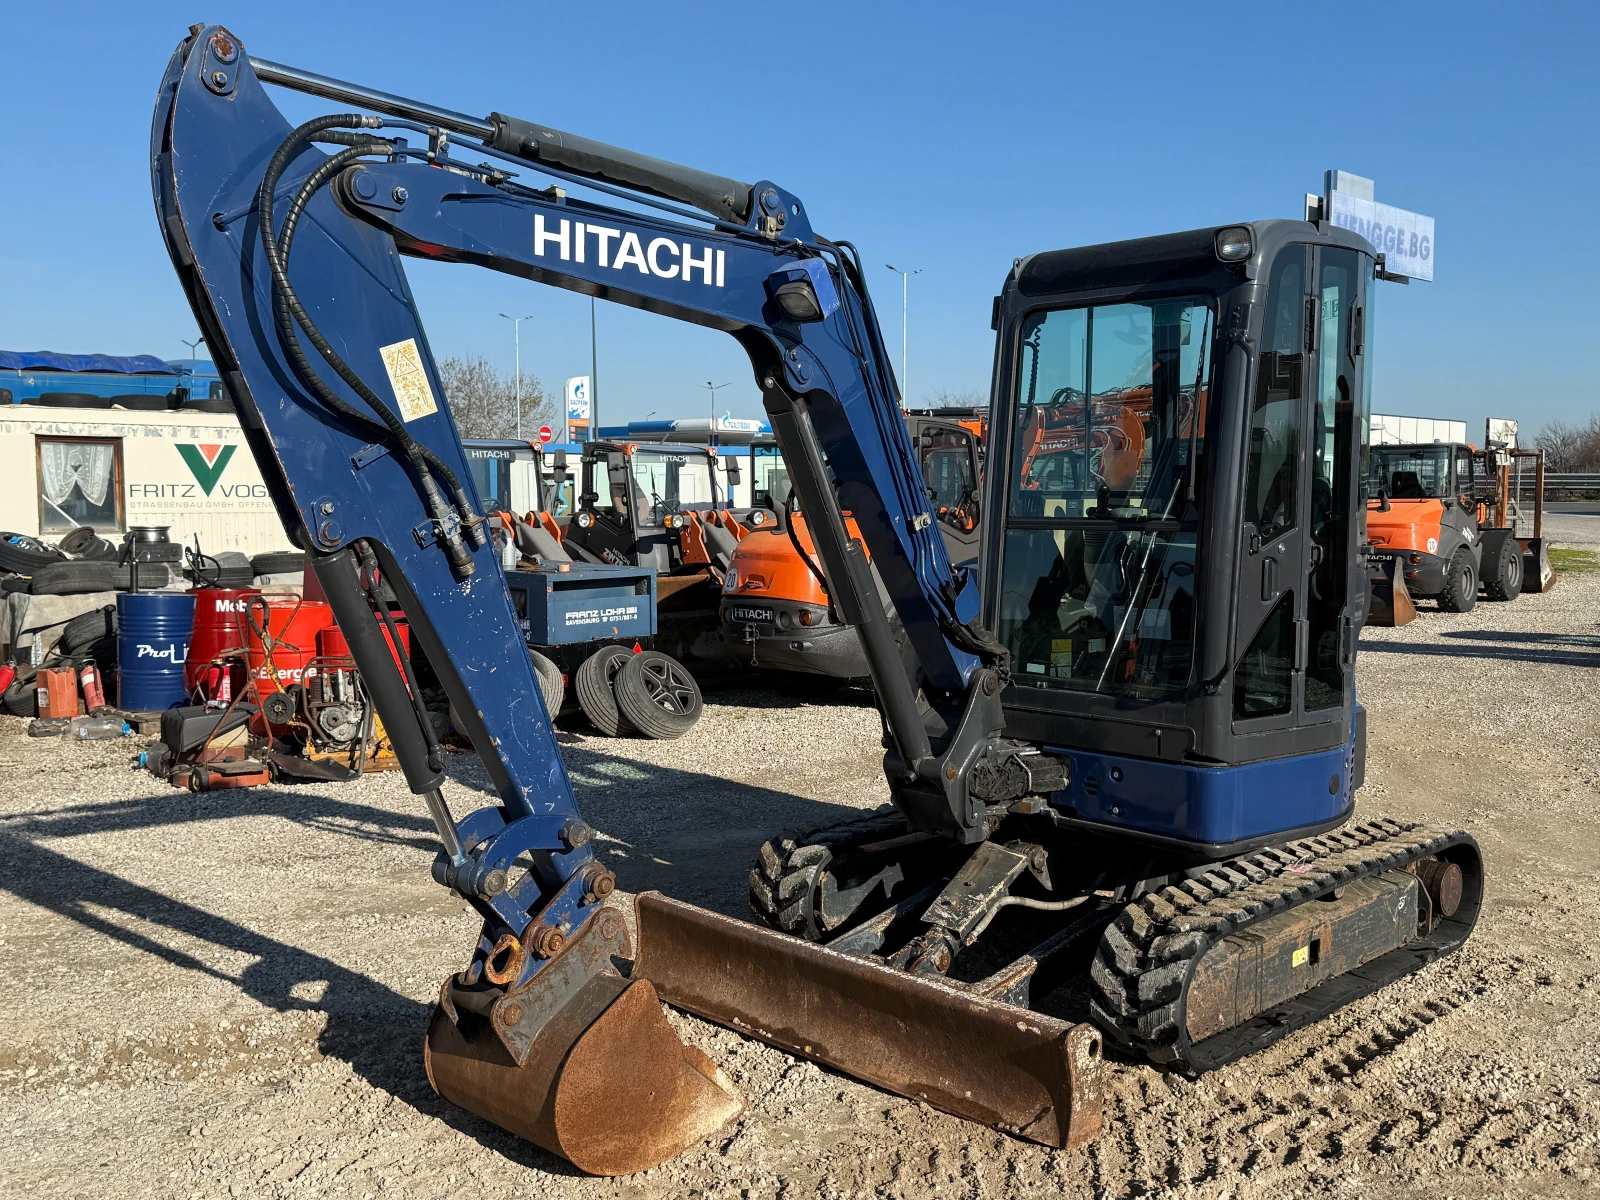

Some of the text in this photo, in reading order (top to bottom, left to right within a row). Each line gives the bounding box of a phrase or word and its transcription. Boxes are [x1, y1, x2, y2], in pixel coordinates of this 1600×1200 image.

[534, 213, 725, 288] HITACHI
[471, 450, 510, 459] HITACHI
[659, 454, 691, 463] HITACHI
[129, 484, 271, 498] FRITZ VOG
[726, 572, 737, 588] 20
[565, 609, 599, 620] FRANZ
[734, 607, 774, 620] HITACHI
[565, 617, 600, 626] RAVENSBURG
